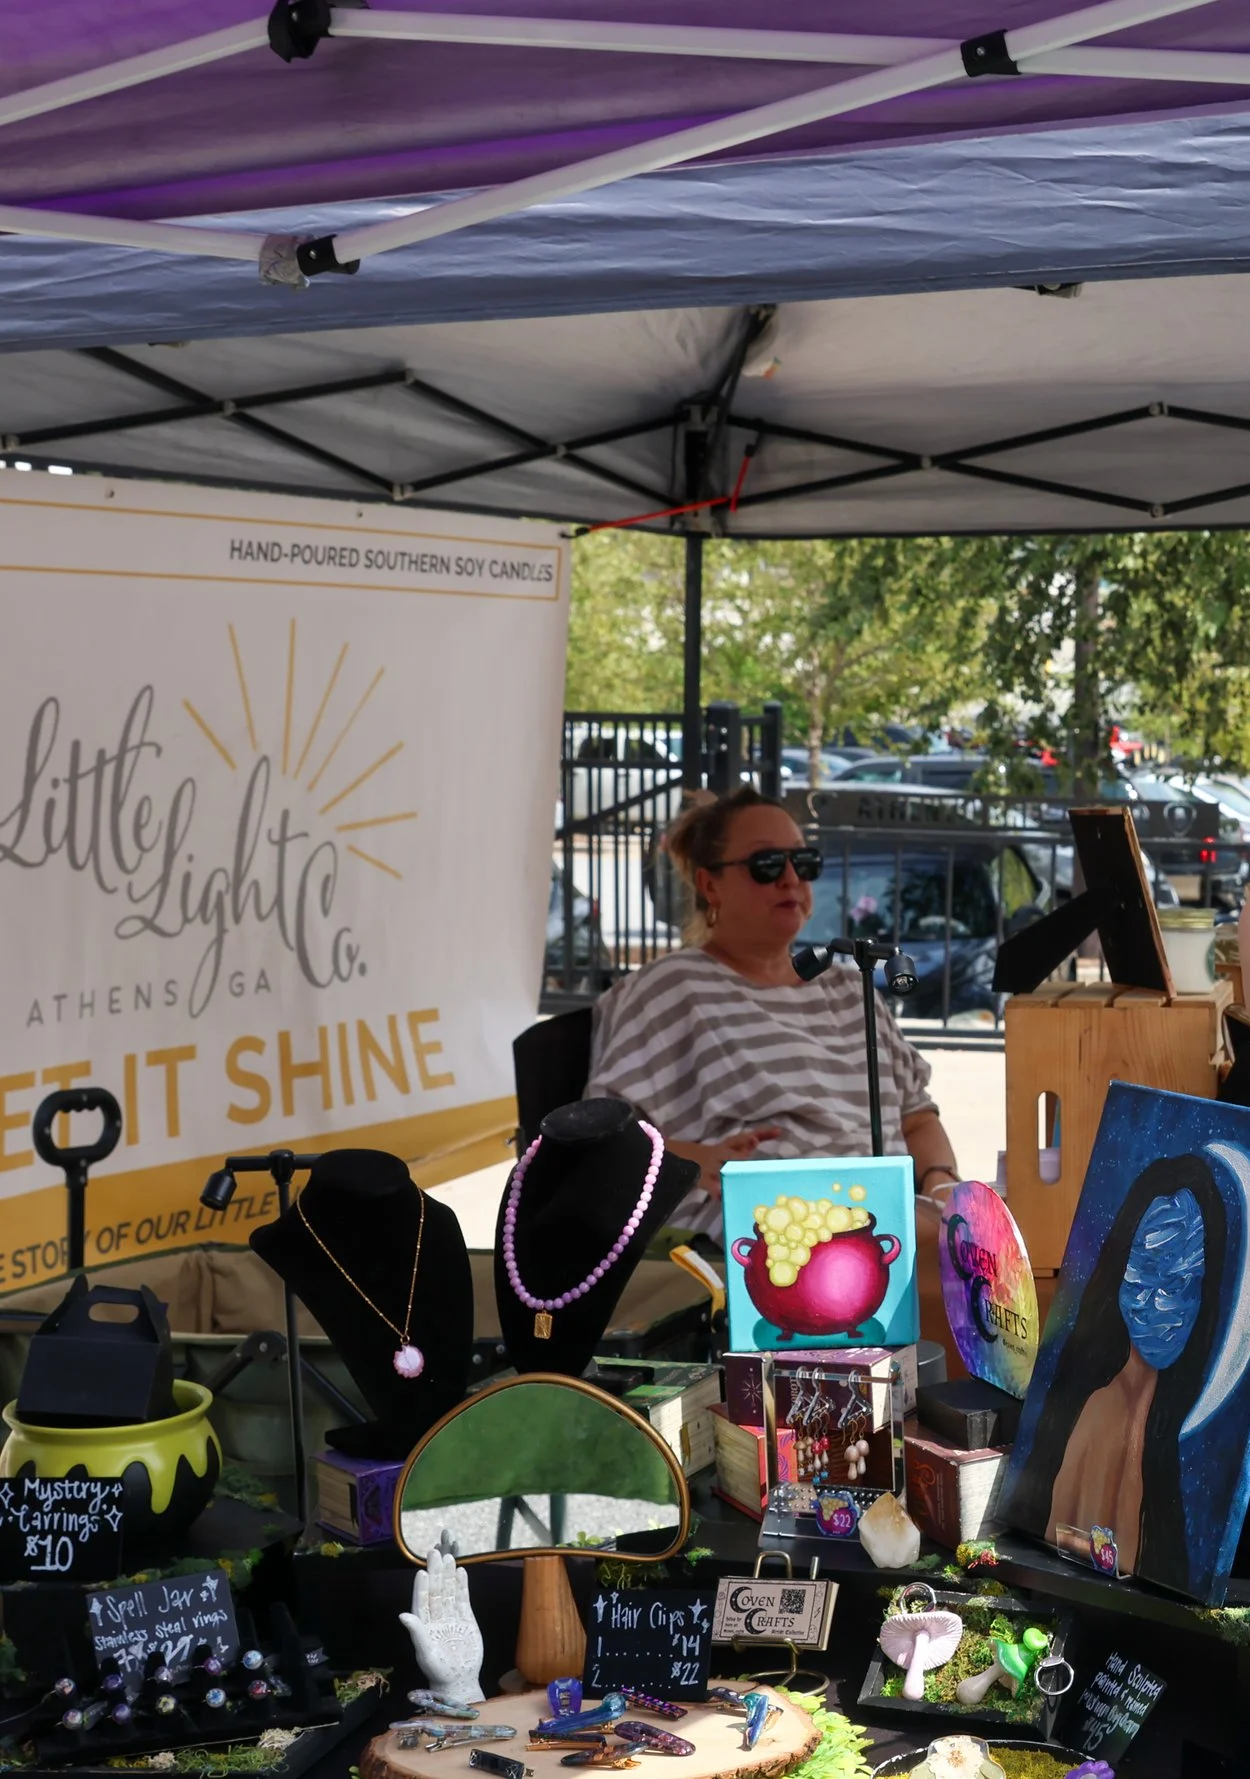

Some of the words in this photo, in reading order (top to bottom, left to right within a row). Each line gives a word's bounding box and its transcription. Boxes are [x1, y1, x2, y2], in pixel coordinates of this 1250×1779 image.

[229, 539, 360, 568] HAND-POURED
[363, 549, 451, 574] SOUTHERN
[454, 556, 485, 577] SOY
[488, 560, 553, 582] CANDLES
[0, 685, 163, 894] Little
[114, 755, 310, 1018] Light
[295, 841, 367, 989] Co.
[26, 979, 179, 1028] ATHENS
[228, 968, 272, 998] GA
[124, 1045, 196, 1146] IT
[225, 1008, 456, 1125] SHINE
[95, 1222, 132, 1254] OF
[135, 1209, 191, 1246] OUR
[24, 1478, 110, 1514] Mystery
[832, 1513, 851, 1528] $22
[24, 1534, 74, 1572] $10
[1100, 1548, 1114, 1565] $45
[106, 1590, 148, 1630] Spell
[158, 1586, 195, 1613] Jar
[192, 1609, 228, 1628] rings
[611, 1602, 642, 1630] Hair
[649, 1601, 685, 1635] Clips
[672, 1633, 700, 1657] $14
[671, 1661, 700, 1686] $22
